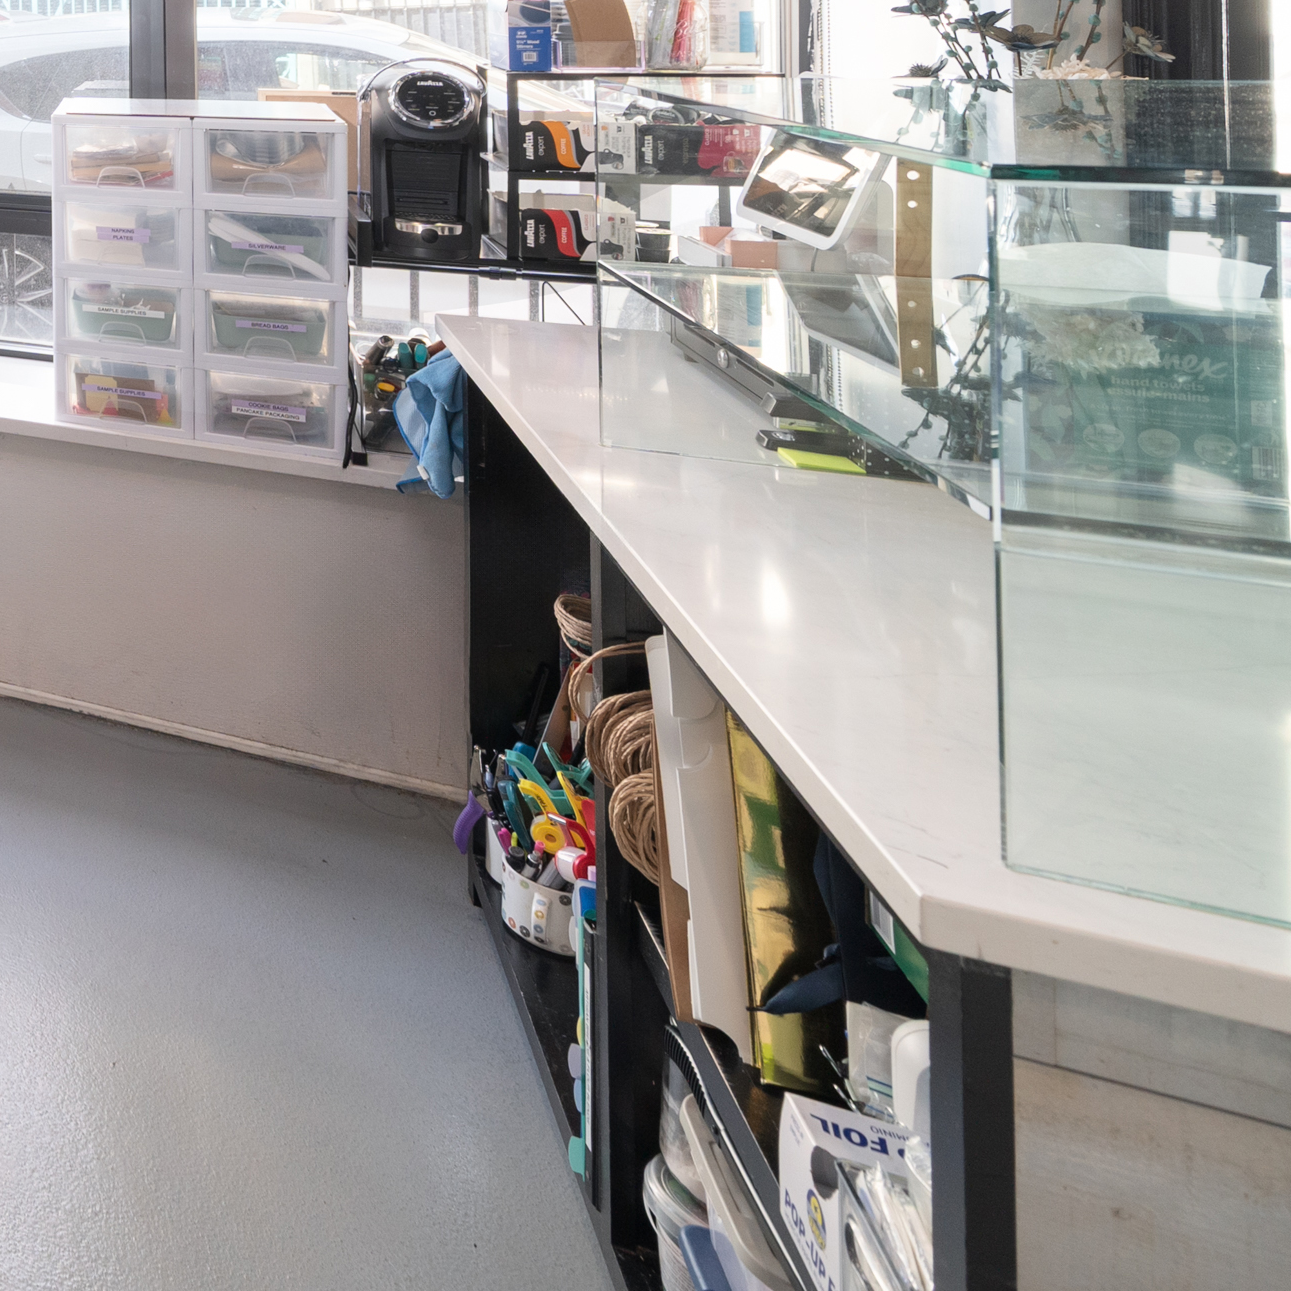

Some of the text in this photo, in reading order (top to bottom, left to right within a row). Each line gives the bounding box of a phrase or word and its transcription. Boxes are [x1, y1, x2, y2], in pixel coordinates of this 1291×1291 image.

[523, 131, 535, 160] LAVAZZA
[641, 134, 653, 165] LAVAZZA
[657, 140, 665, 161] expert
[112, 234, 134, 242] PLATES
[524, 218, 535, 248] LAVAZZA
[248, 243, 286, 251] SILVERWARE
[98, 306, 147, 316] SAMPLE SUPPLIES
[1111, 375, 1150, 386] hand
[97, 385, 146, 397] SAMPLE SUPPLIES
[248, 401, 271, 409] COOKIE
[236, 407, 300, 421] PANCAKE PACKAGING
[810, 1113, 889, 1156] FOIL
[784, 1187, 806, 1238] POP
